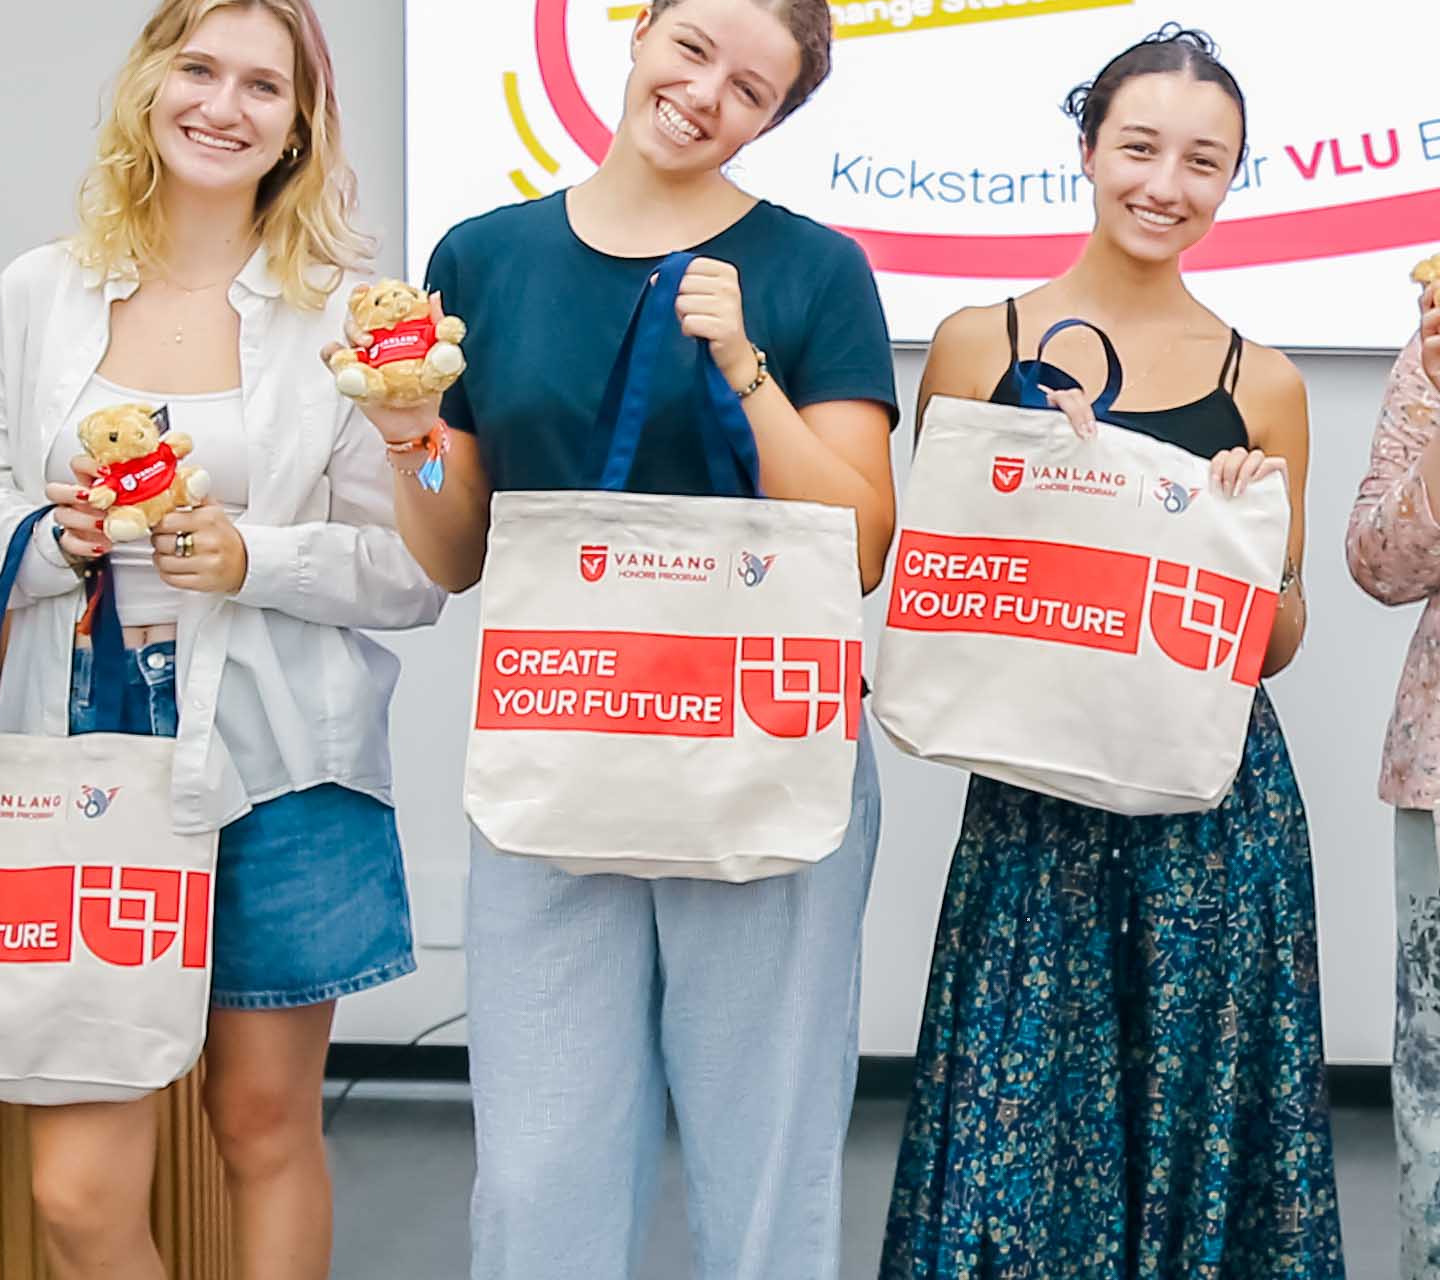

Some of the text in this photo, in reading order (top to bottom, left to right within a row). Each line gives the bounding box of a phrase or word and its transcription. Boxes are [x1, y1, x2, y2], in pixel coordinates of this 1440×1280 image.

[1284, 128, 1401, 181] VLU
[1032, 466, 1126, 486] VANLANG
[614, 553, 716, 570] VANLANG
[903, 549, 1030, 583] CREATE
[897, 588, 1126, 637] YOUR FUTURE
[494, 648, 618, 677] CREATE
[492, 688, 722, 722] YOUR FUTURE
